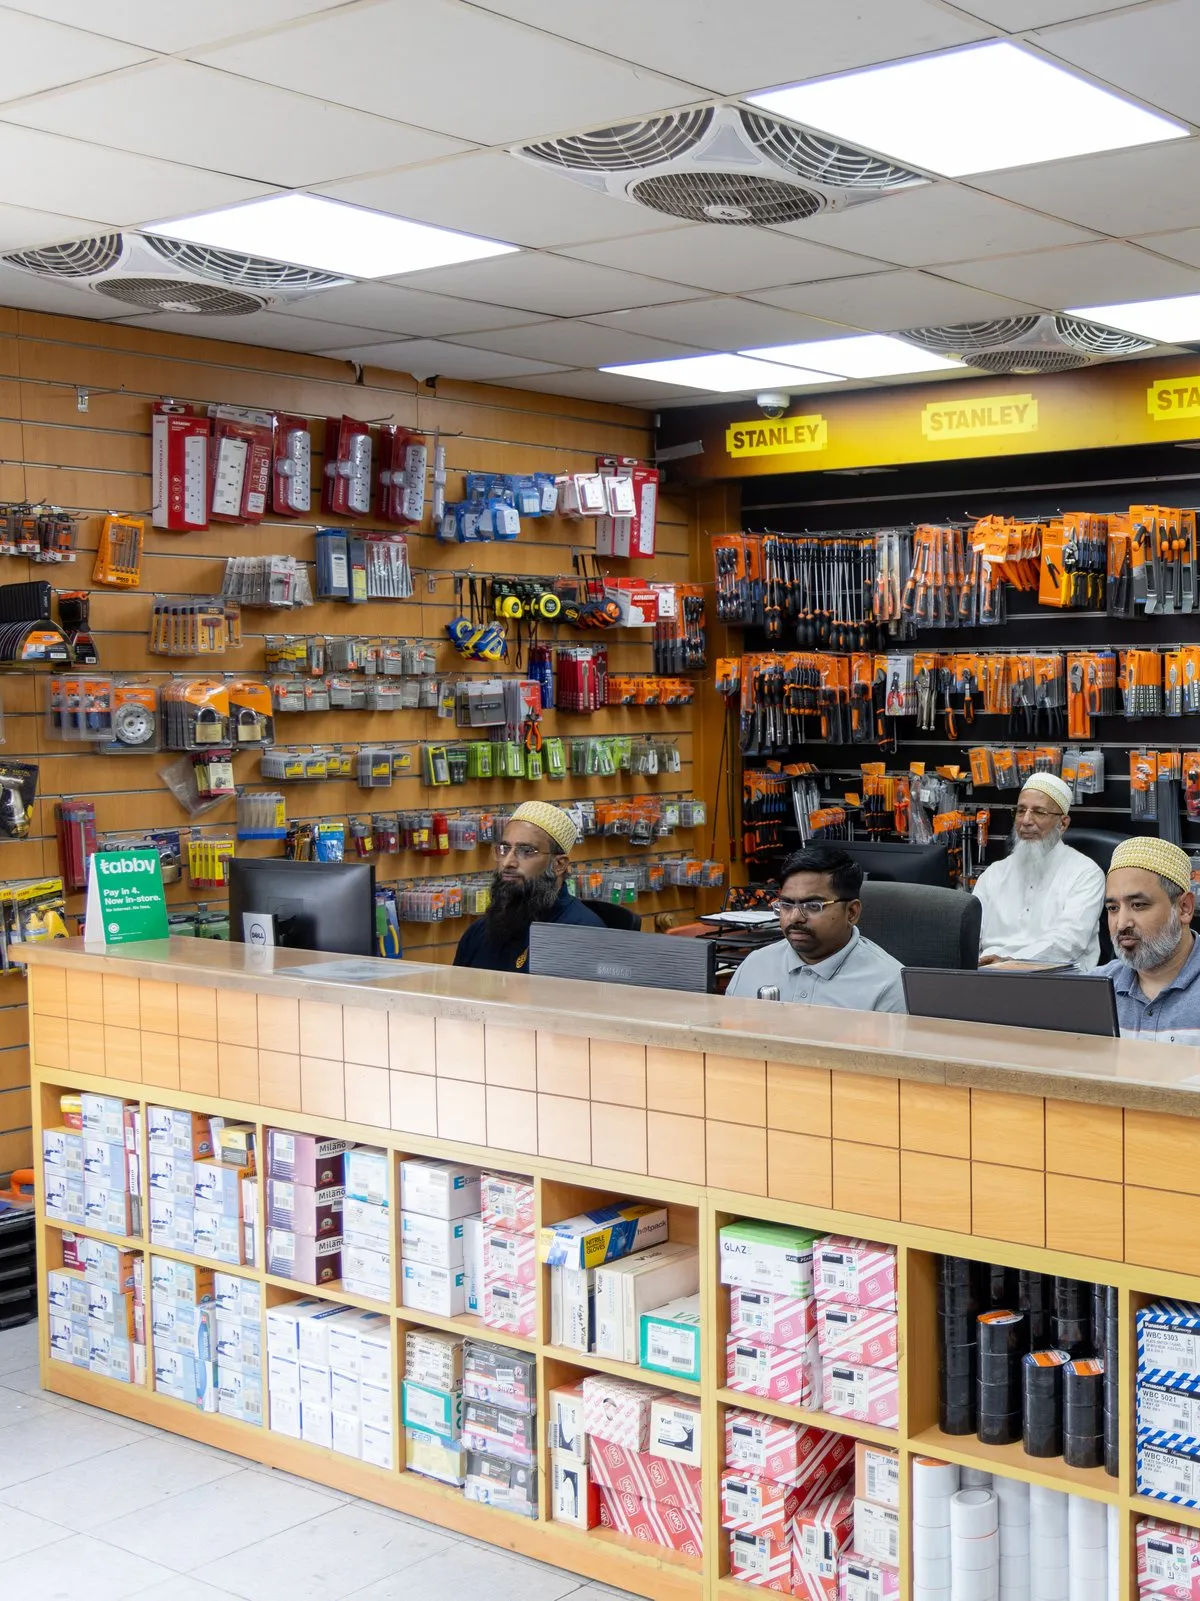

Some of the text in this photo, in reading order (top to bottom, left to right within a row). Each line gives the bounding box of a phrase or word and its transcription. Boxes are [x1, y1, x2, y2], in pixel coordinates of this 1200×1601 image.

[929, 405, 1029, 432] STANLEY
[732, 426, 820, 449] STANLEY
[100, 857, 156, 875] tabby
[103, 888, 119, 898] Pay
[131, 886, 140, 894] 4.
[105, 894, 161, 905] Now in-store.
[319, 1140, 346, 1153] Milano
[318, 1187, 346, 1200] Milano
[585, 1234, 605, 1246] NITRILE
[586, 1243, 605, 1256] GLOVES
[1144, 1321, 1170, 1330] Panasonic
[1145, 1331, 1179, 1342] WBC 5303
[1141, 1381, 1167, 1391] Panasonic
[1142, 1389, 1177, 1403] WBC 5021
[1143, 1442, 1169, 1453] Panasonic
[1143, 1451, 1178, 1465] WBC 5021
